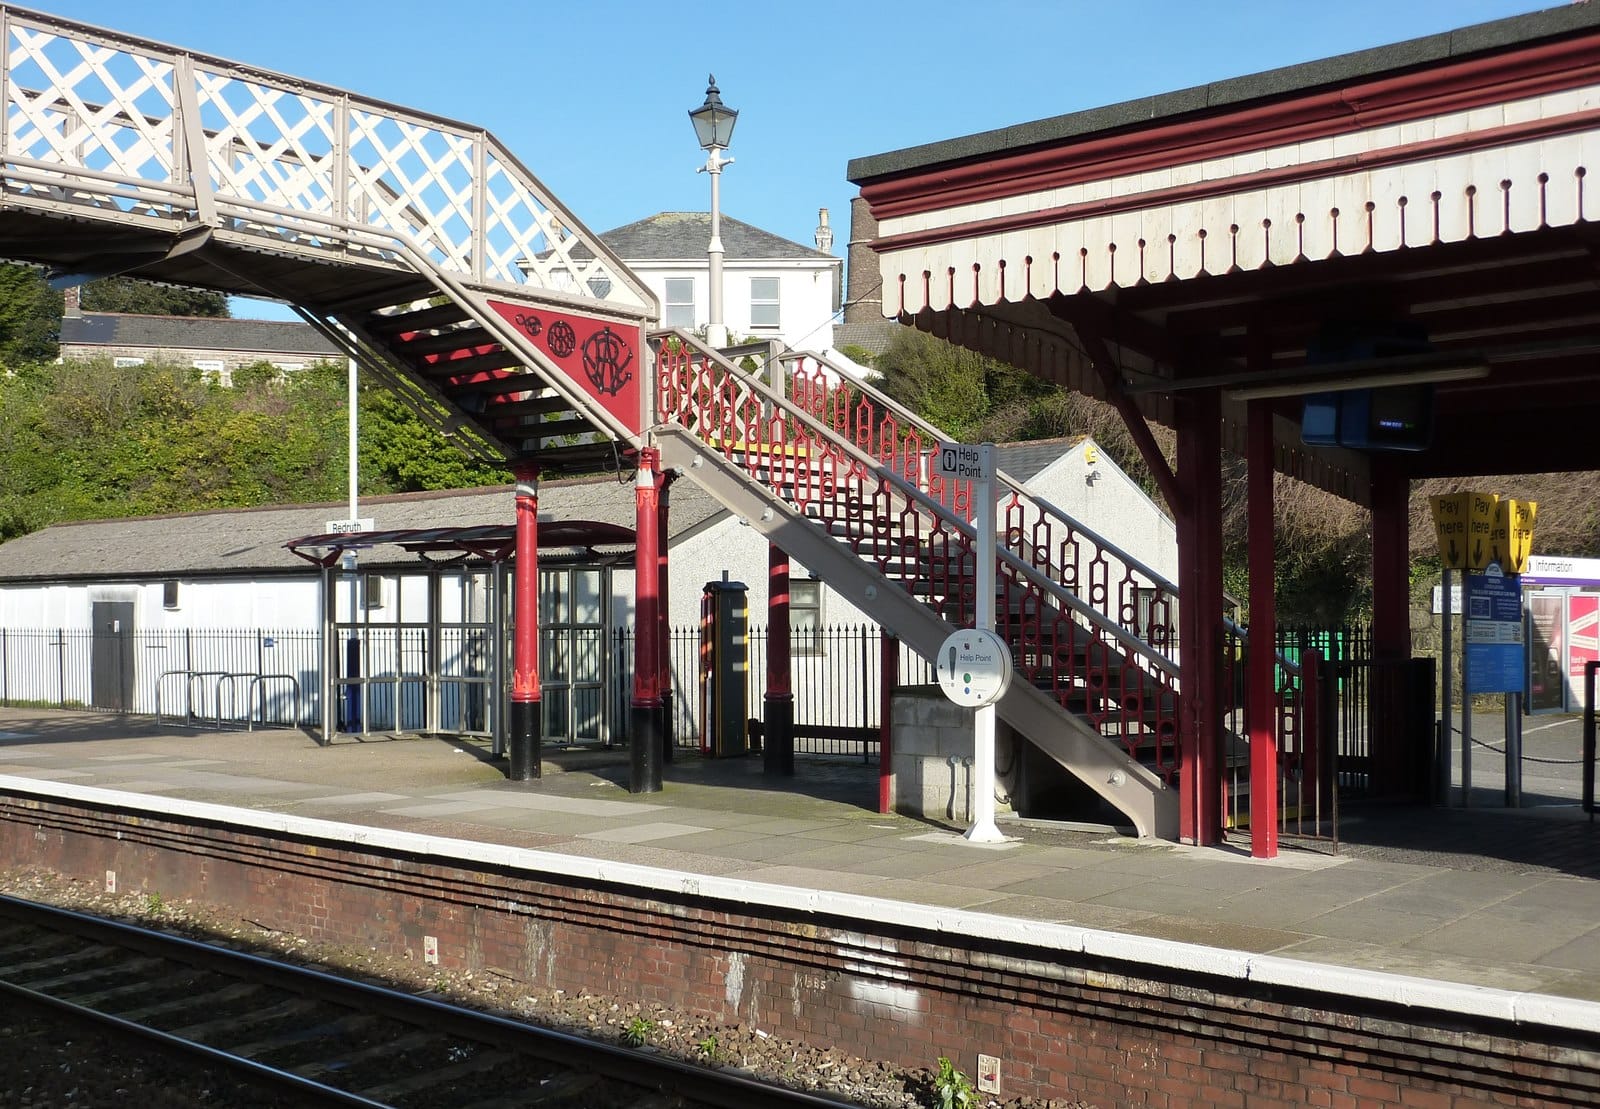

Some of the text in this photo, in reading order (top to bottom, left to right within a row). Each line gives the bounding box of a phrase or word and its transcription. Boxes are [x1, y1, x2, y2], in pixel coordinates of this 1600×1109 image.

[958, 447, 979, 464] Help
[958, 463, 981, 478] Point
[1439, 500, 1459, 514] Pay
[1474, 497, 1490, 515] Pay
[1515, 505, 1530, 522] Pay
[332, 522, 362, 534] Redruth
[1439, 520, 1464, 535] here
[1471, 519, 1490, 535] here
[1512, 527, 1530, 540] here
[1535, 559, 1573, 573] Information
[959, 653, 992, 663] Help Point
